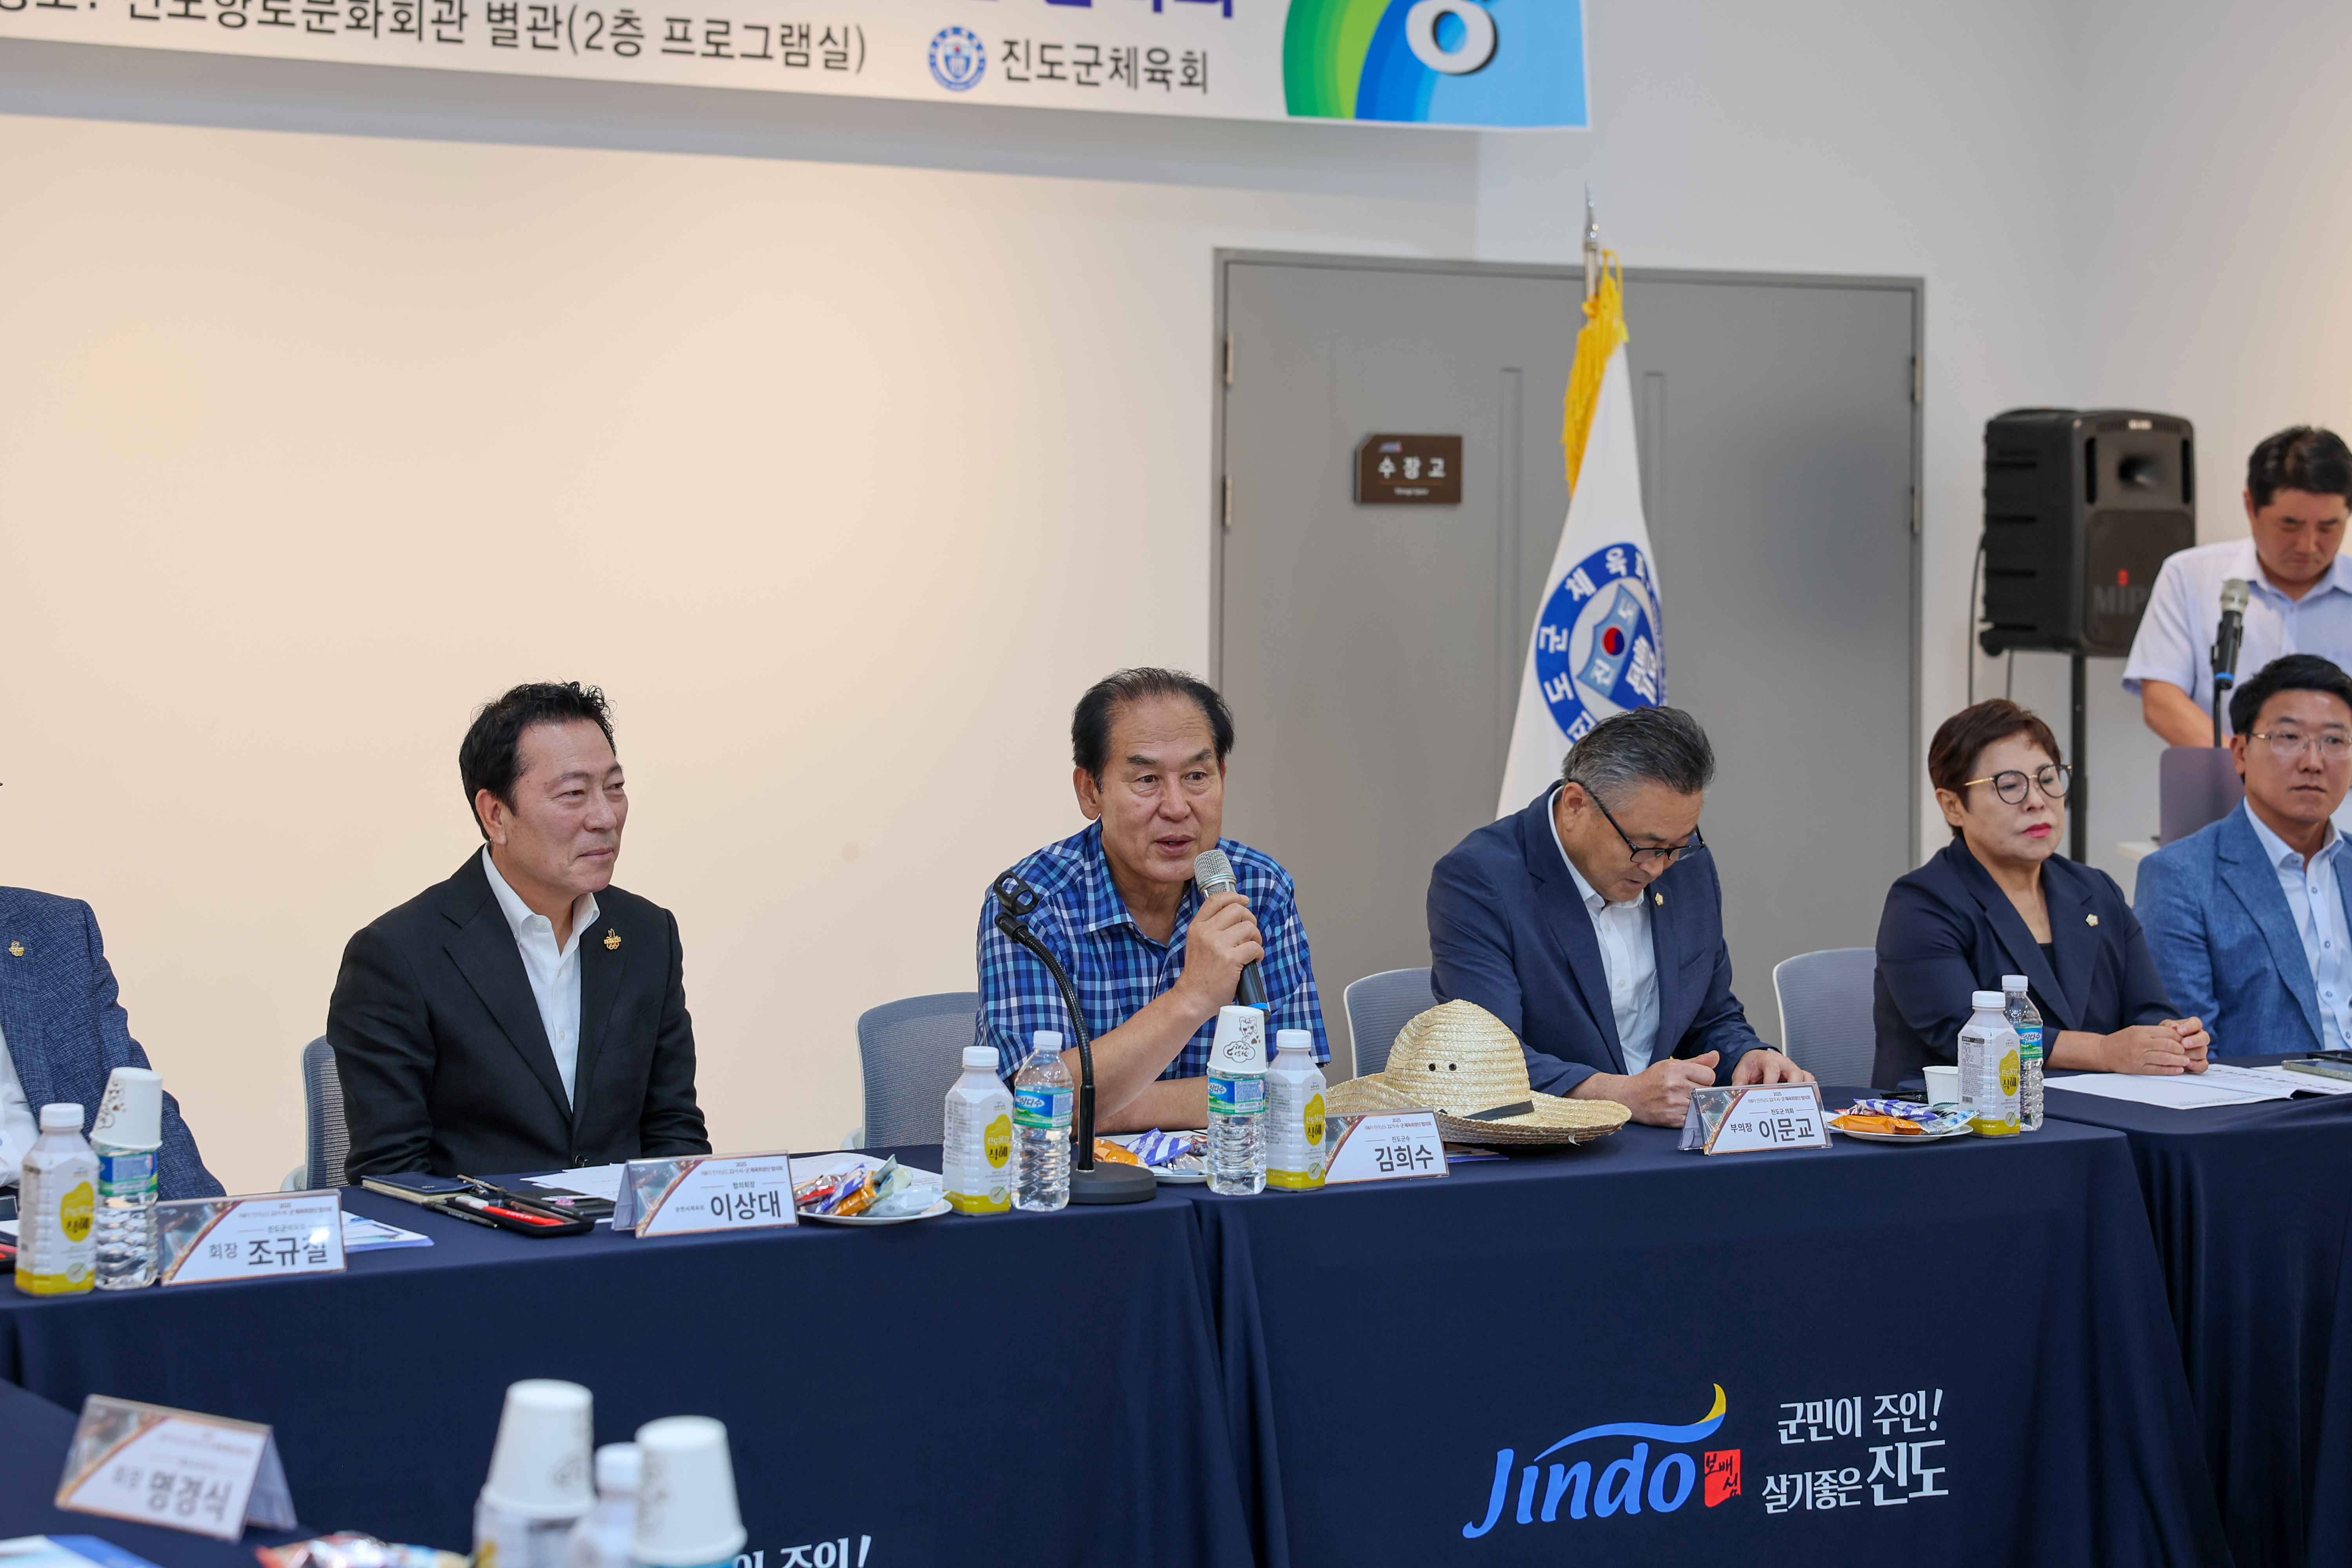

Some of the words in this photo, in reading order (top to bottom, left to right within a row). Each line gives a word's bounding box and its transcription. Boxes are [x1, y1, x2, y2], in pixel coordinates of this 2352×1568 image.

[487, 2, 645, 57] 별관(2층
[661, 17, 865, 74] 프로그램실)
[1002, 38, 1208, 94] 진도군체육회
[2024, 1033, 2040, 1042] 삼다수
[1209, 1085, 1225, 1094] 삼다수
[2003, 1077, 2016, 1089] 식혜
[1020, 1097, 1042, 1107] 삼다수
[1307, 1124, 1321, 1138] 식혜
[1730, 1122, 1752, 1133] 부의장
[1759, 1118, 1815, 1143] 이문교
[989, 1146, 1008, 1160] 식혜
[1374, 1144, 1434, 1172] 김희수
[733, 1181, 755, 1189] 협의회장
[711, 1190, 782, 1221] 이상대
[209, 1242, 238, 1259] 회장
[1778, 1396, 1862, 1444] 군민이
[1872, 1388, 1943, 1435] 주인!
[1762, 1467, 1863, 1514] 살기좋은
[1866, 1439, 1949, 1506] 진도
[1462, 1442, 1696, 1539] Jindo
